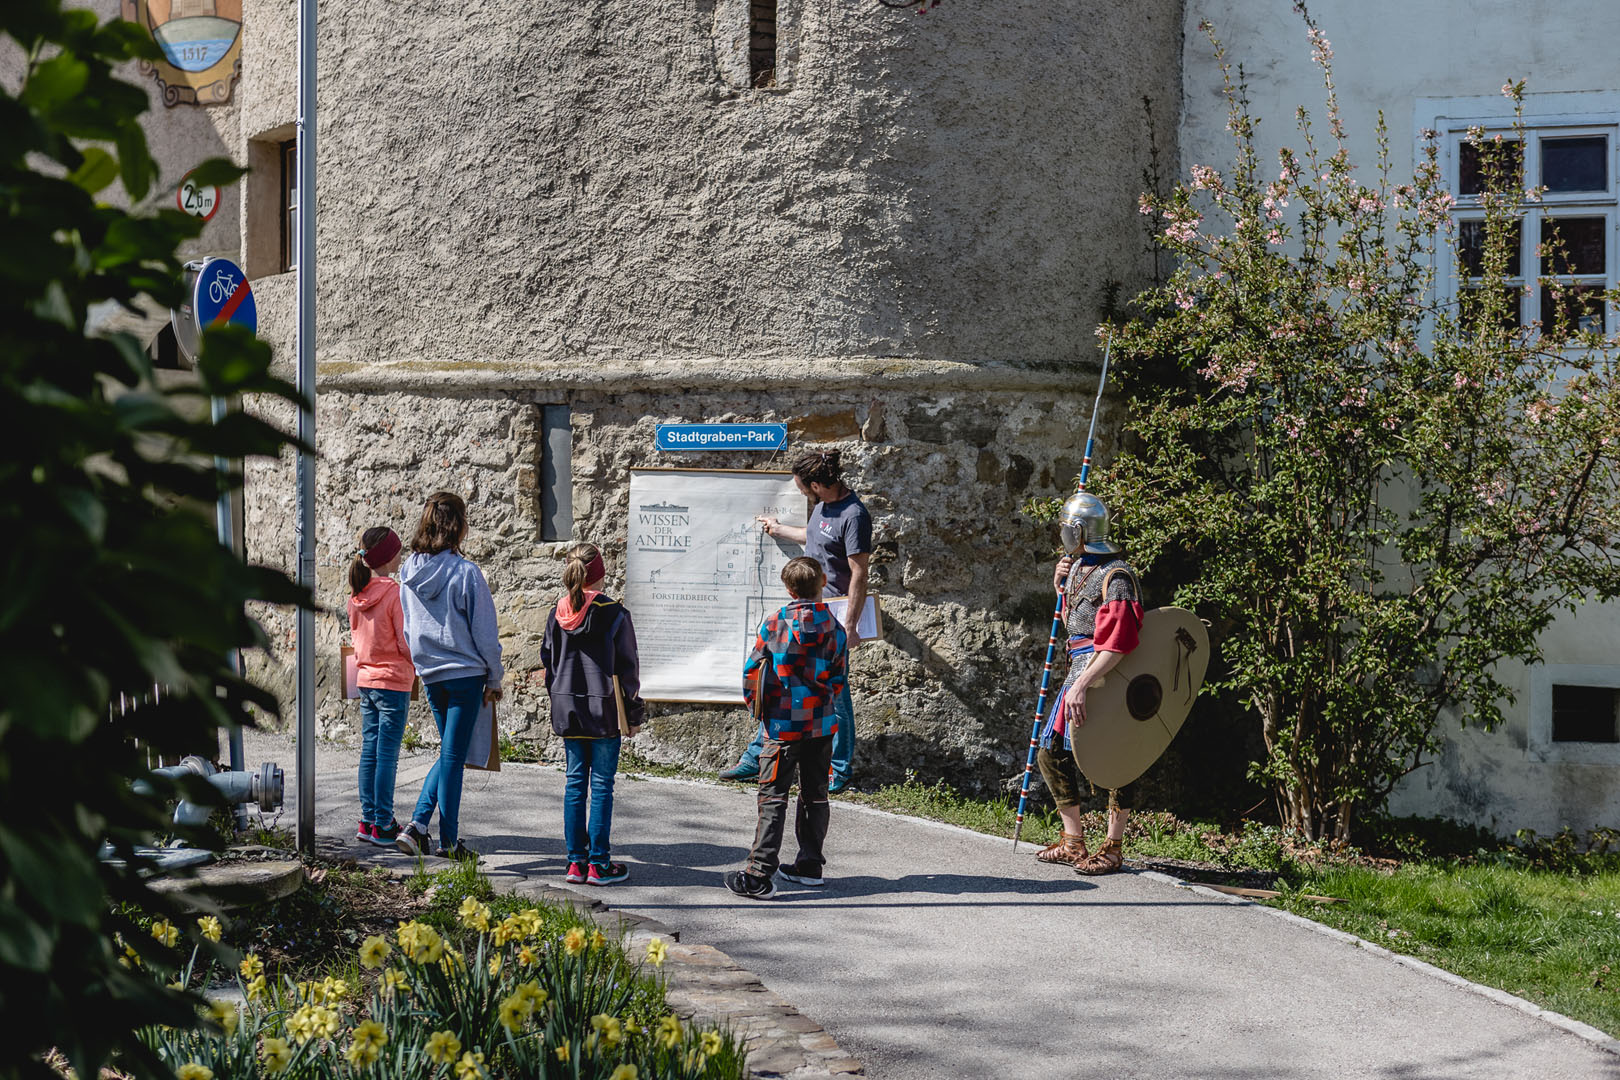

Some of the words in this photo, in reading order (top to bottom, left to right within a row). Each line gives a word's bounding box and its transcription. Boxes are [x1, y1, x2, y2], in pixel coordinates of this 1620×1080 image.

[183, 46, 208, 62] 1517
[667, 431, 775, 444] Stadtgraben-Park
[638, 514, 690, 526] WISSEN
[654, 526, 672, 535] DER
[635, 534, 691, 548] ANTIKE
